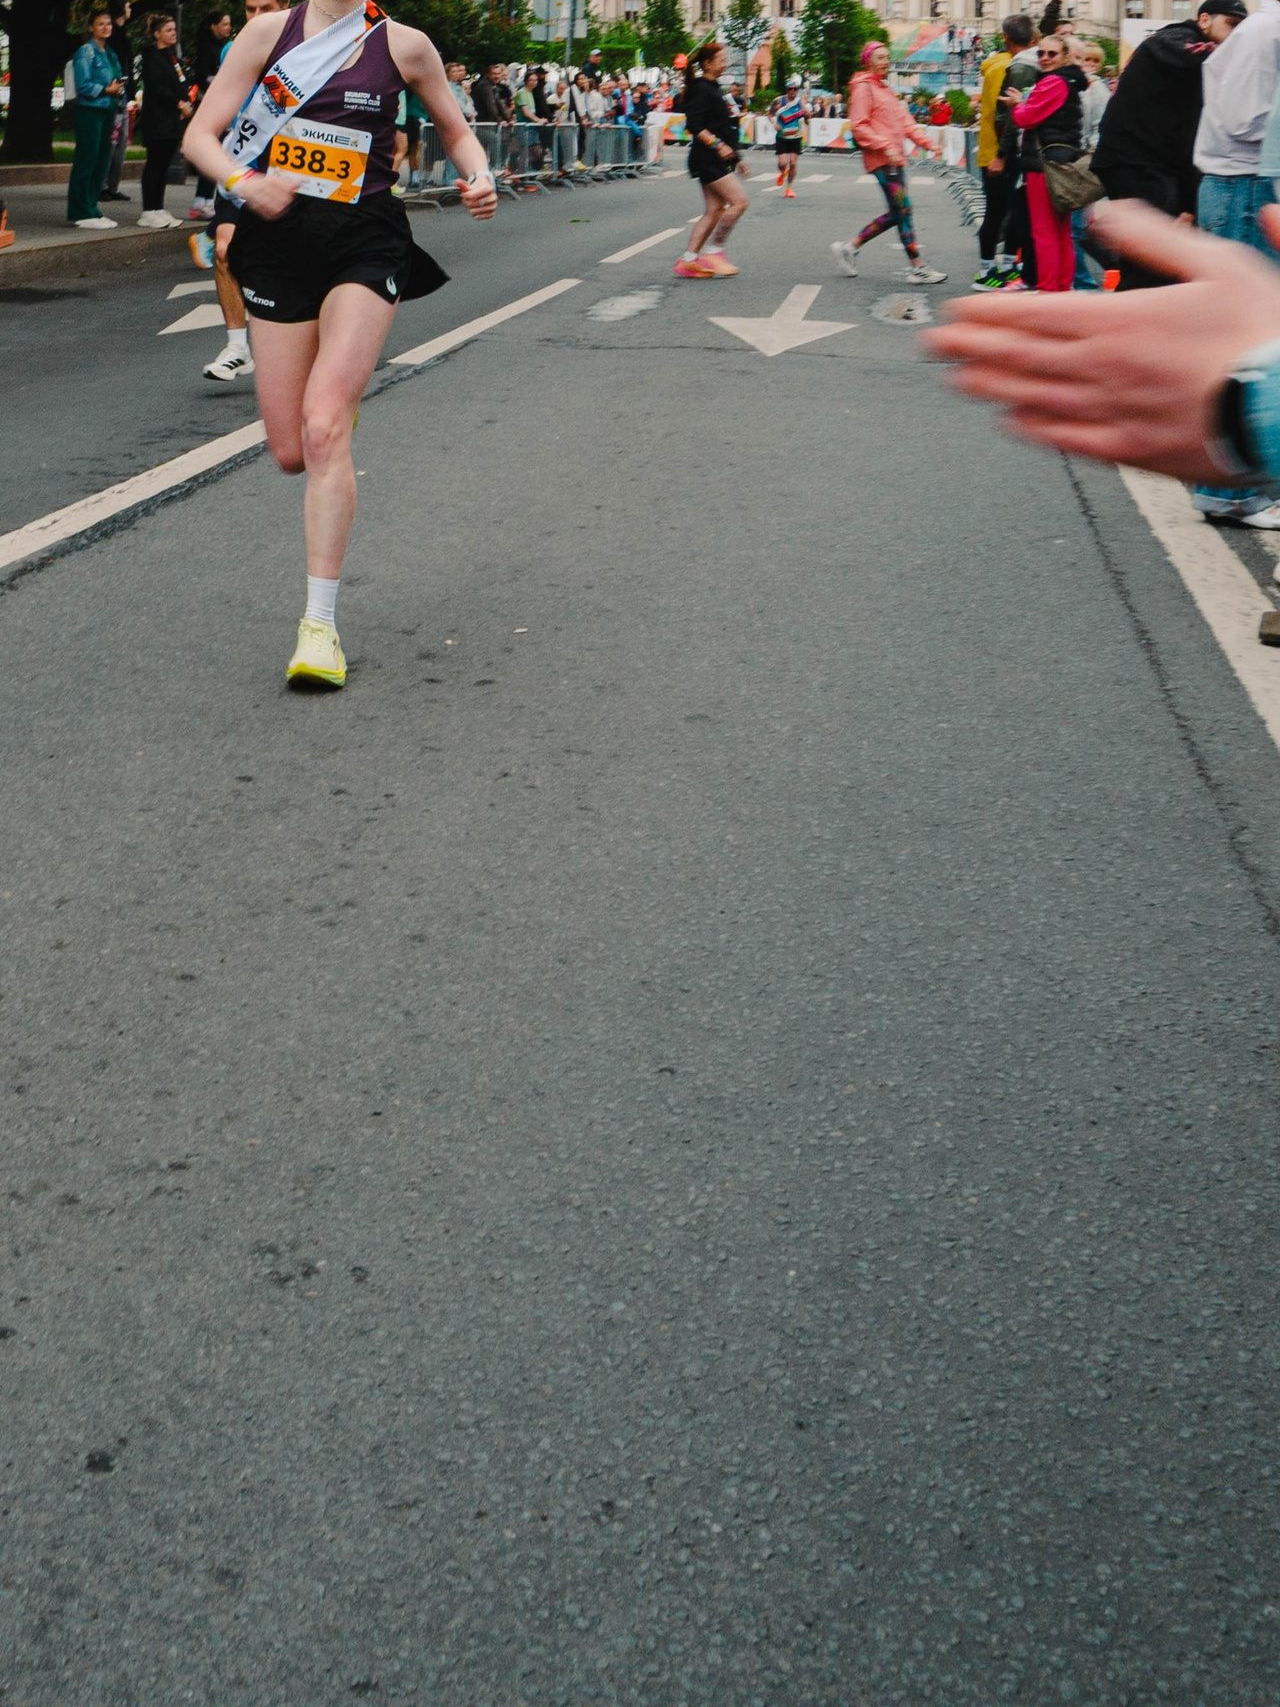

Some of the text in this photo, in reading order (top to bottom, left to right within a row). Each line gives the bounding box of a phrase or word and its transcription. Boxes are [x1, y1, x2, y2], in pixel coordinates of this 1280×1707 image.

[273, 64, 305, 99] ЭКИДЕН
[368, 99, 380, 107] CLUB
[275, 141, 351, 180] 338-3
